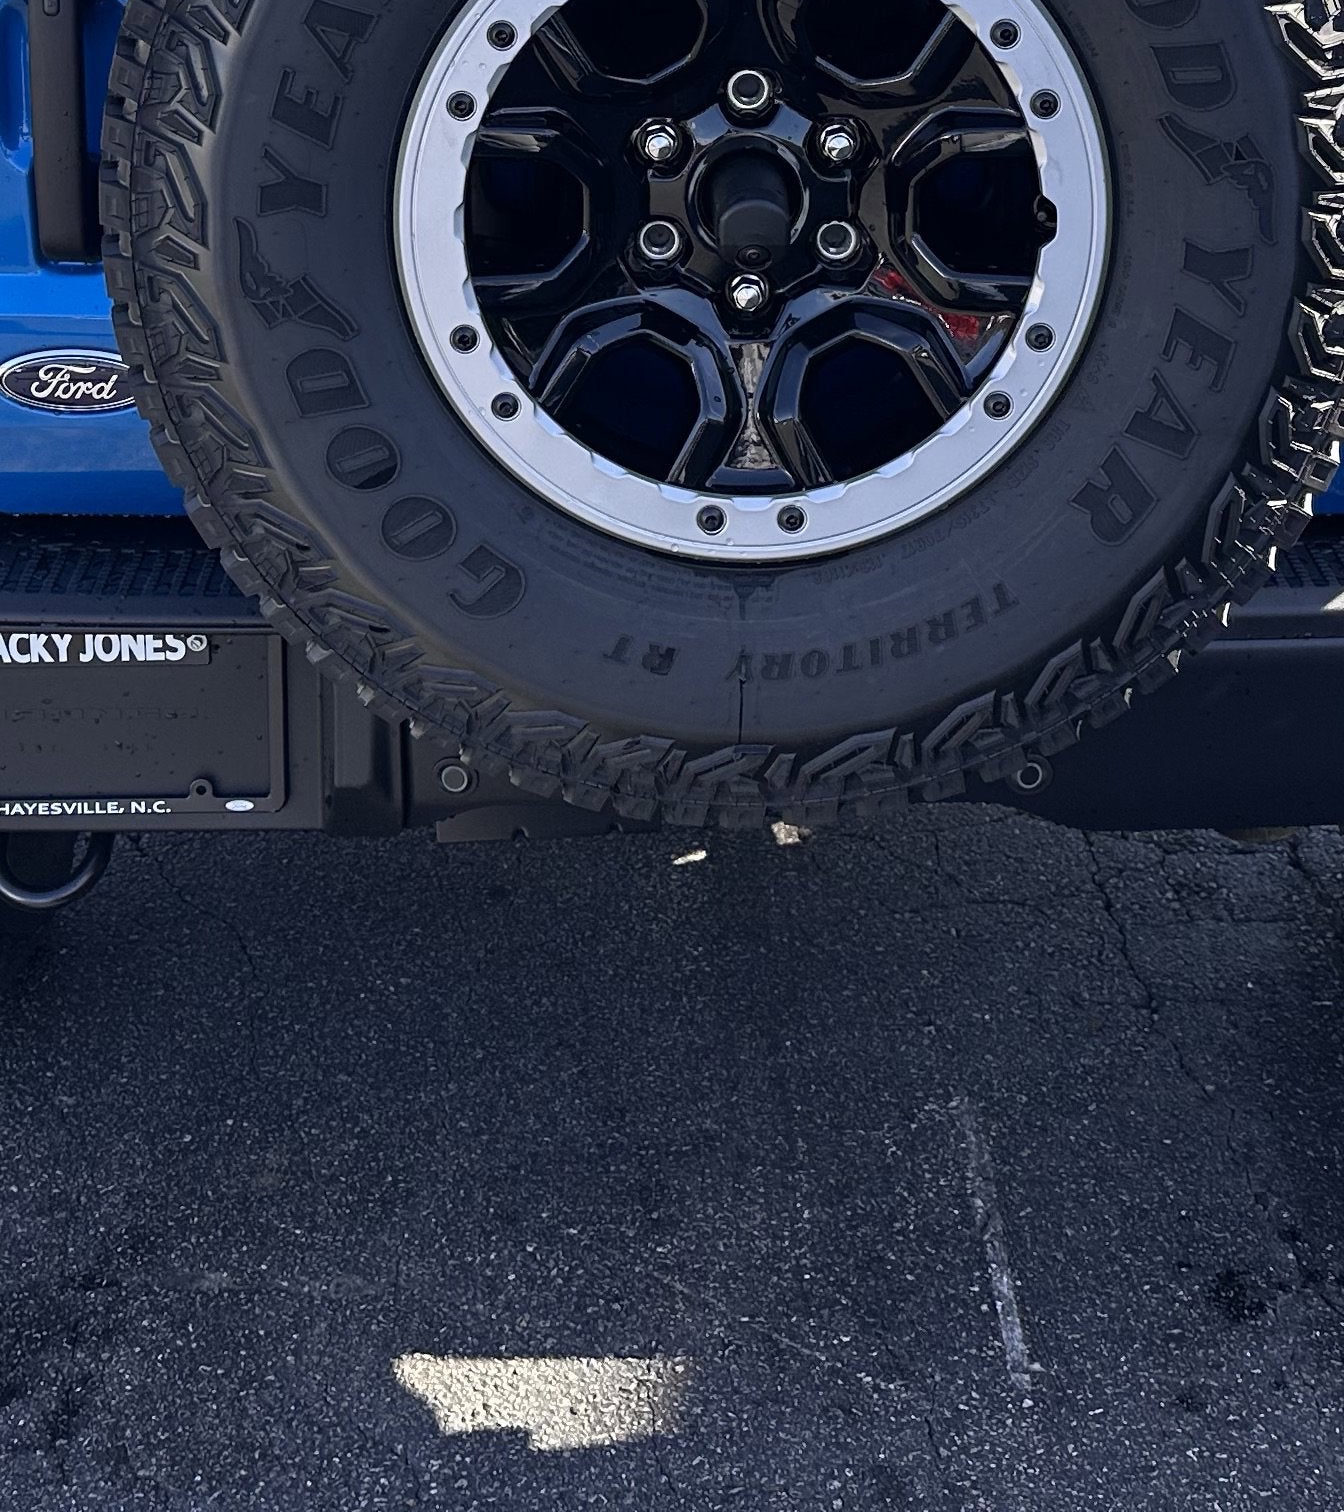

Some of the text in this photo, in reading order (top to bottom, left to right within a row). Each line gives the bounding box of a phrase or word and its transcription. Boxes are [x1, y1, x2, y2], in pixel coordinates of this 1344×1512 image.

[30, 364, 119, 400] Ford
[79, 632, 187, 663] JONES
[602, 579, 1020, 683] TERRITORY RT
[130, 800, 172, 815] N.C.
